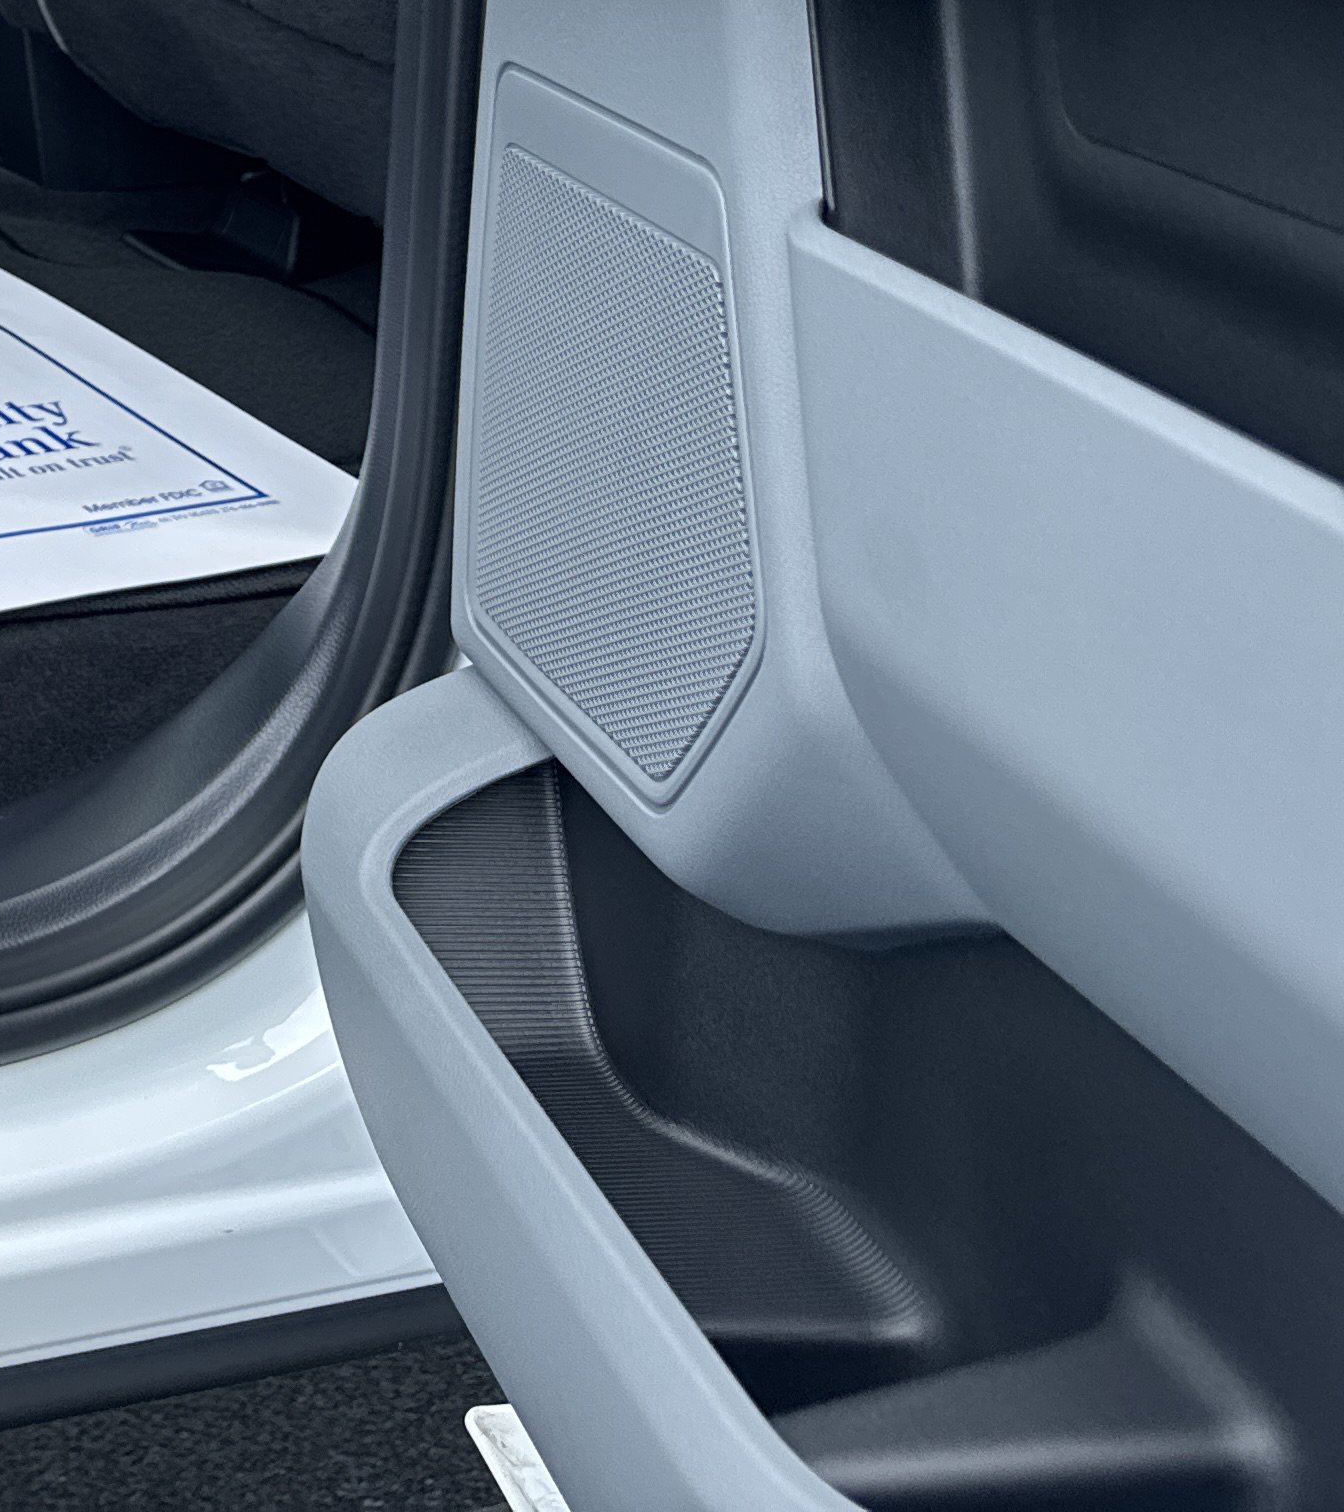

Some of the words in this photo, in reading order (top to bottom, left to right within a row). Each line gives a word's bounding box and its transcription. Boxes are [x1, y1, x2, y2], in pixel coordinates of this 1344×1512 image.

[28, 461, 67, 476] on
[82, 493, 159, 514] Member
[158, 487, 203, 503] FDIC
